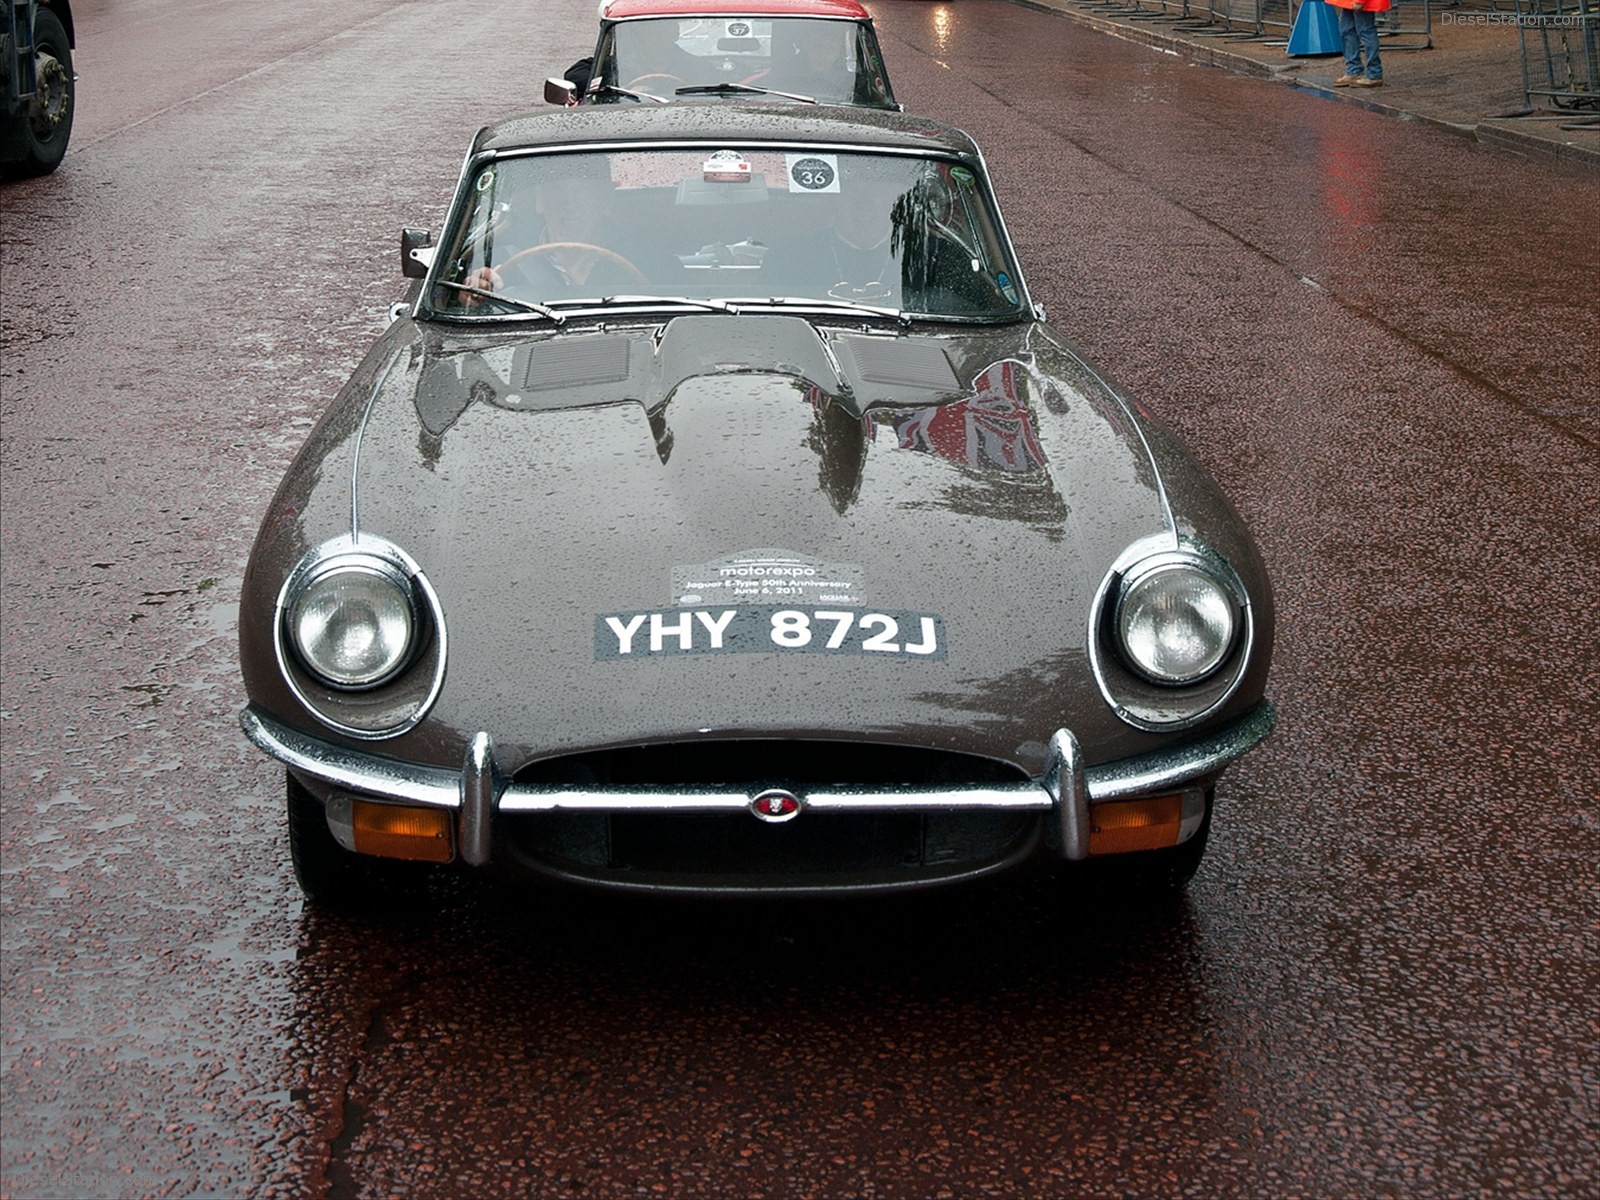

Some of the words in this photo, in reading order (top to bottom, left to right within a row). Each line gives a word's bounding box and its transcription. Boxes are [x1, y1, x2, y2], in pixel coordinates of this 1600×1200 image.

[801, 171, 826, 185] 36
[720, 566, 815, 578] motorexpo
[686, 581, 723, 590] Jaguar
[725, 580, 759, 588] E-Type
[788, 579, 852, 589] Anniversary
[733, 587, 759, 595] June
[761, 587, 773, 595] 6,
[775, 587, 803, 595] 2011
[604, 610, 738, 654] YHY
[769, 610, 938, 655] 872J
